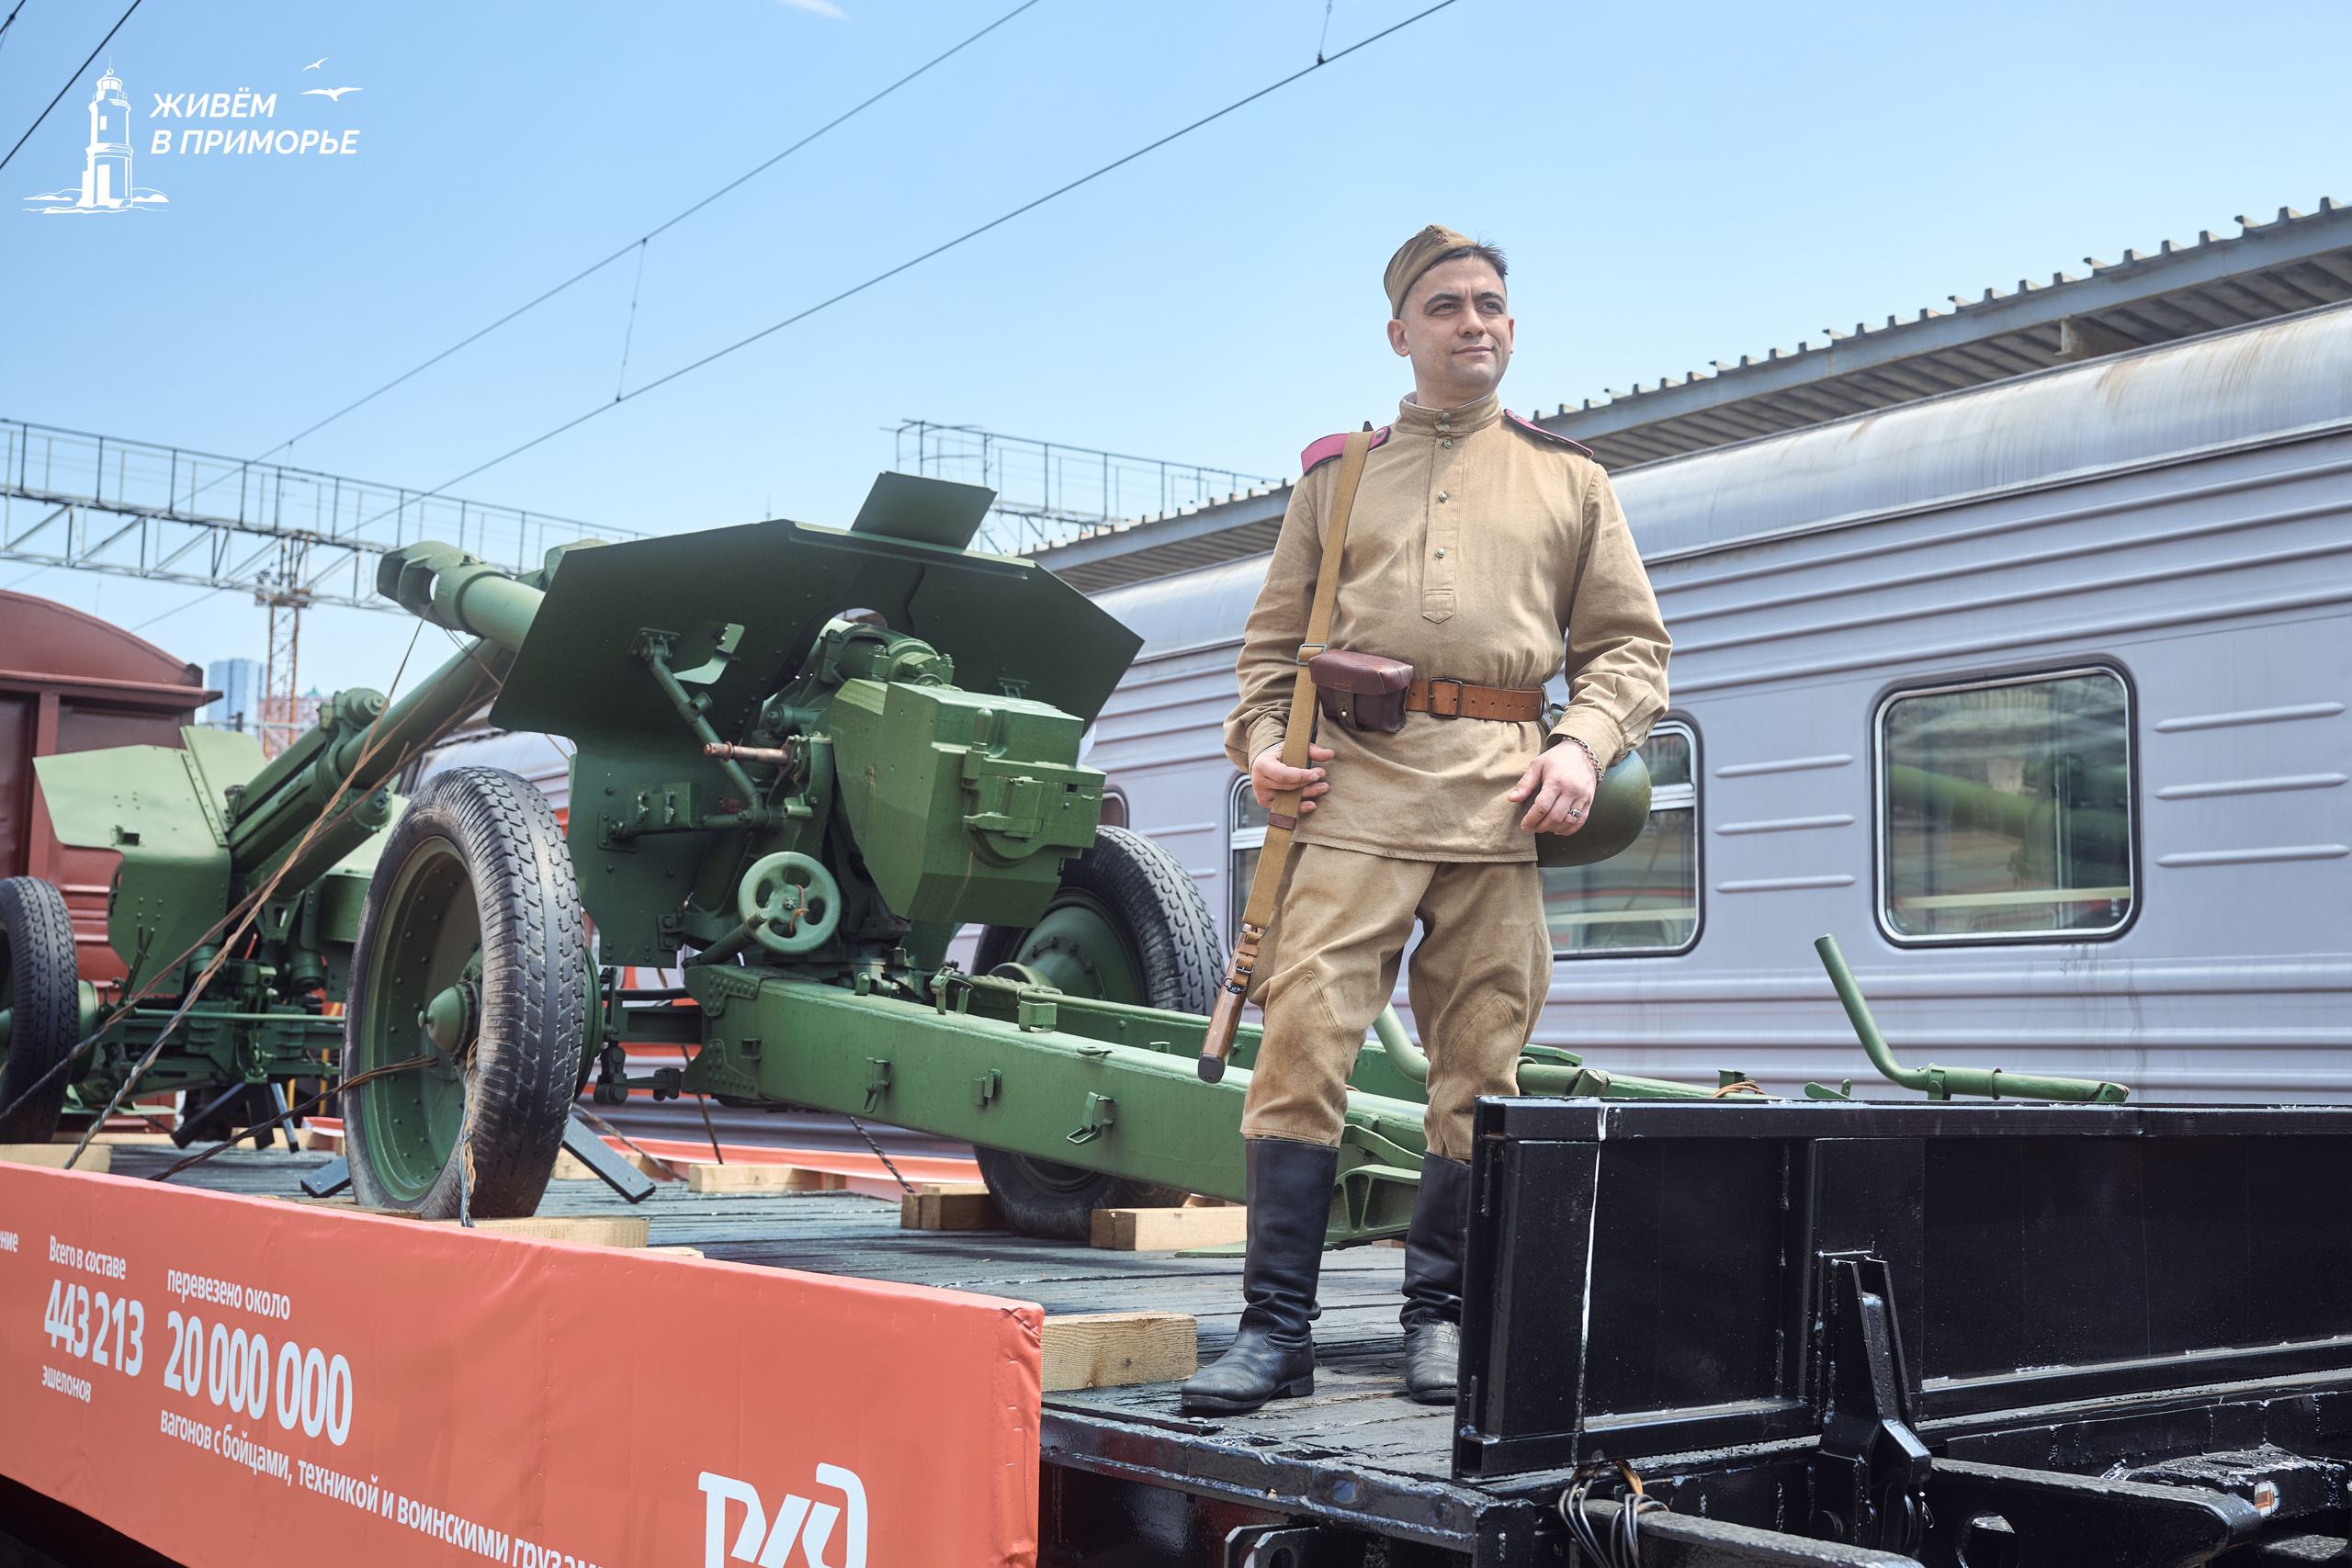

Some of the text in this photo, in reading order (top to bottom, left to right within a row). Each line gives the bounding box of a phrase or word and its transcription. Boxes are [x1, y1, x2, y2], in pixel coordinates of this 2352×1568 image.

[0, 1230, 18, 1253] ние
[49, 1235, 127, 1280] Всего в составе
[167, 1269, 291, 1321] перевезено около
[44, 1279, 145, 1377] 443 213
[41, 1364, 92, 1404] эшелонов
[164, 1310, 353, 1447] 20 000 000
[160, 1409, 212, 1450] вагонов
[213, 1429, 221, 1455] с
[222, 1423, 293, 1487] бойцами,
[297, 1459, 379, 1514] техникой
[381, 1489, 395, 1520] и
[397, 1495, 510, 1564] воинскими
